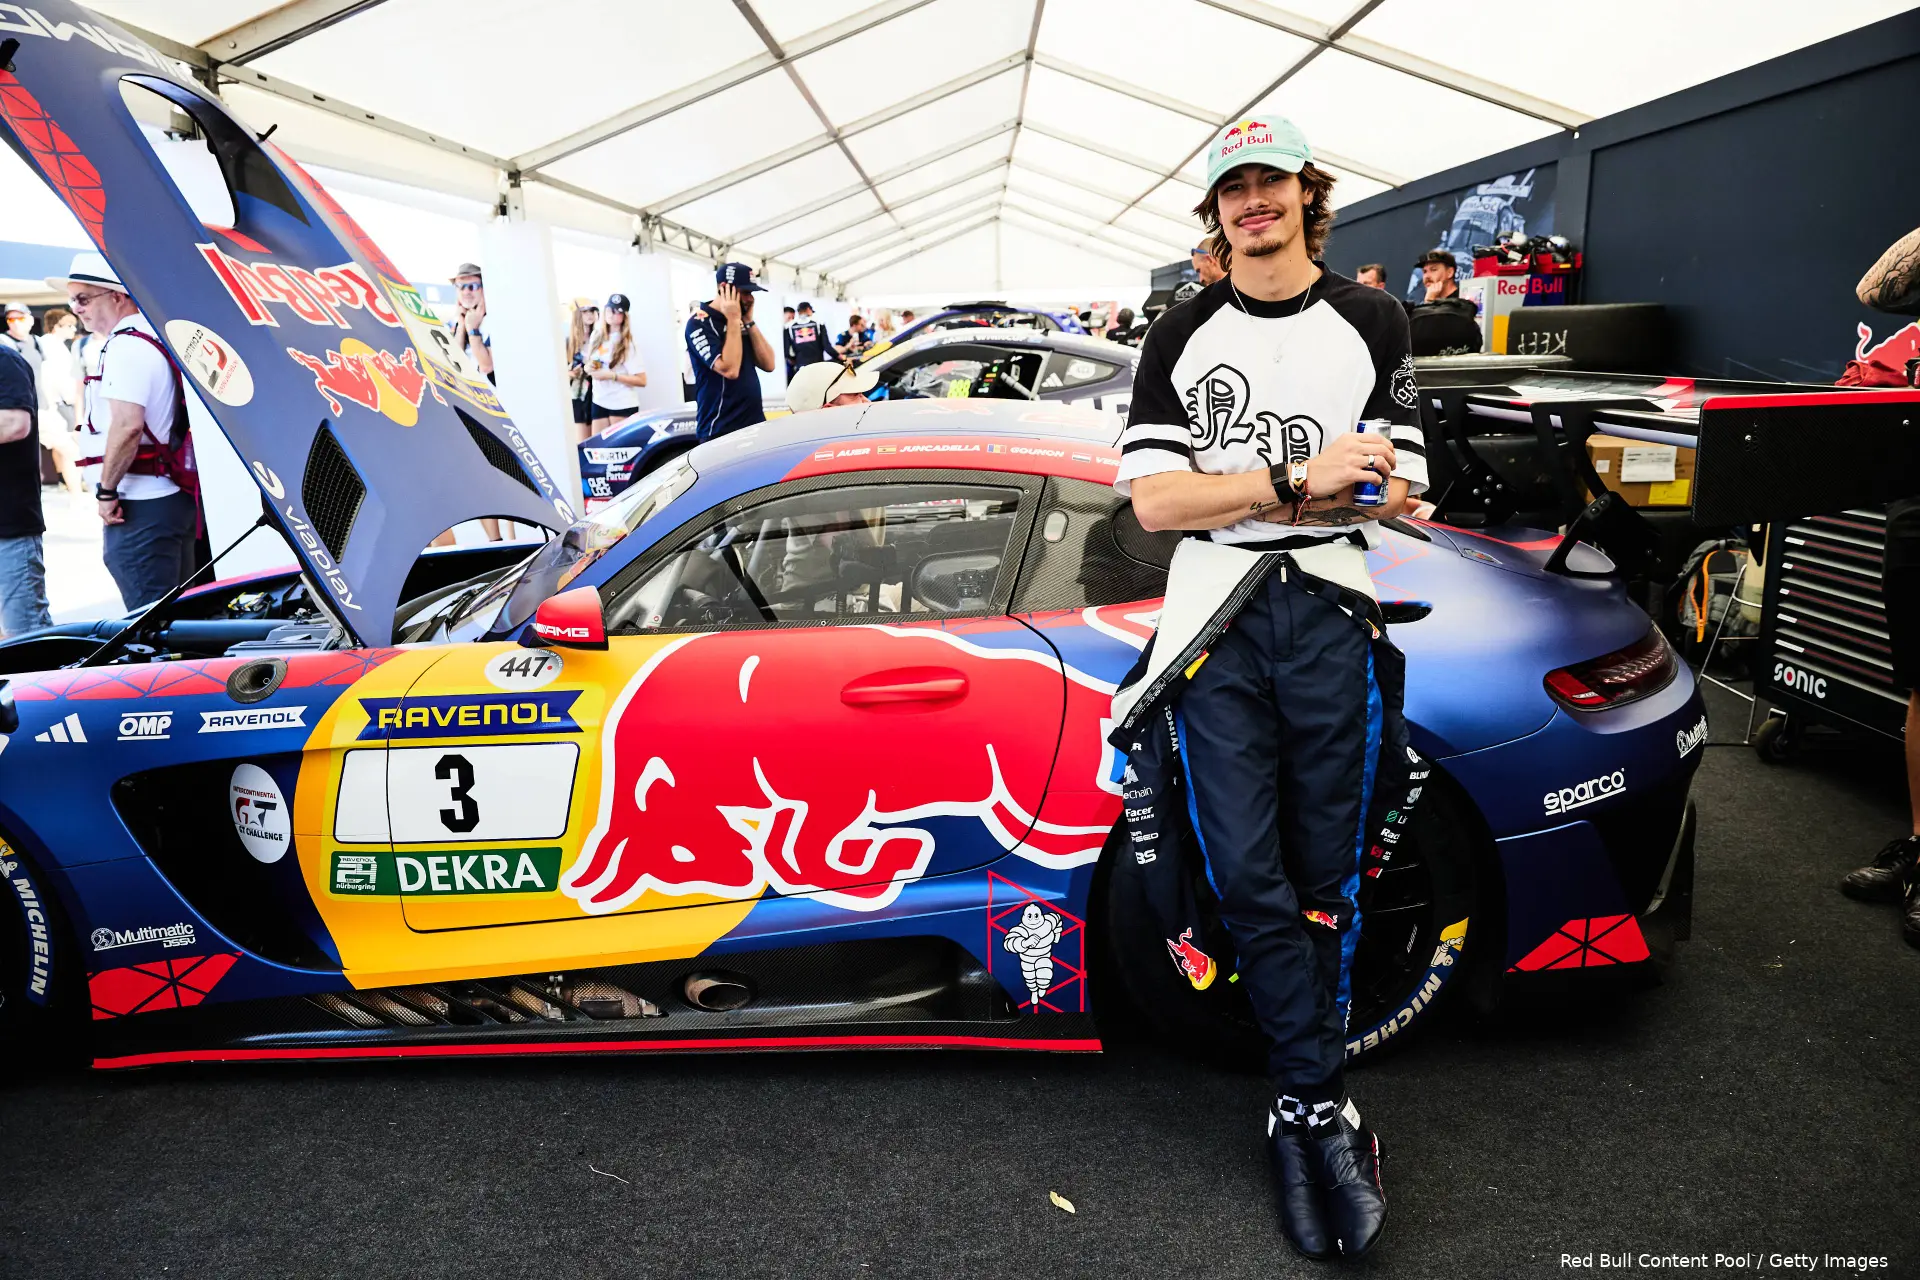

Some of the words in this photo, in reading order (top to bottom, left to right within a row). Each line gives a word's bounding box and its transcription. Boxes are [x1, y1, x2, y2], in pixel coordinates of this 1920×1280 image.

[1221, 138, 1243, 158] Red
[1247, 134, 1272, 144] Bull
[195, 242, 335, 328] Bull
[281, 262, 405, 329] Red
[1497, 279, 1528, 295] Red
[1532, 278, 1562, 294] Bull
[430, 330, 461, 373] 3
[1517, 330, 1568, 355] KEEP
[502, 423, 555, 497] viaplay
[836, 448, 870, 458] AUER
[899, 444, 980, 453] JUNCADELLA
[1010, 446, 1064, 457] GOUNON
[285, 505, 363, 611] viaplay
[544, 626, 589, 638] AMG
[498, 656, 550, 678] 447
[119, 716, 172, 736] OMP
[209, 713, 296, 727] RAVENOL
[377, 702, 562, 730] RAVENOL
[233, 785, 277, 799] INTERCONTINENTAL
[434, 754, 481, 834] 3
[1544, 770, 1625, 813] sparco
[239, 825, 246, 834] GT
[246, 828, 284, 841] CHALLENGE
[396, 852, 546, 892] DEKRA
[336, 883, 376, 892] nürburgring
[12, 878, 49, 996] MICHELIN
[114, 922, 195, 945] Multimatic
